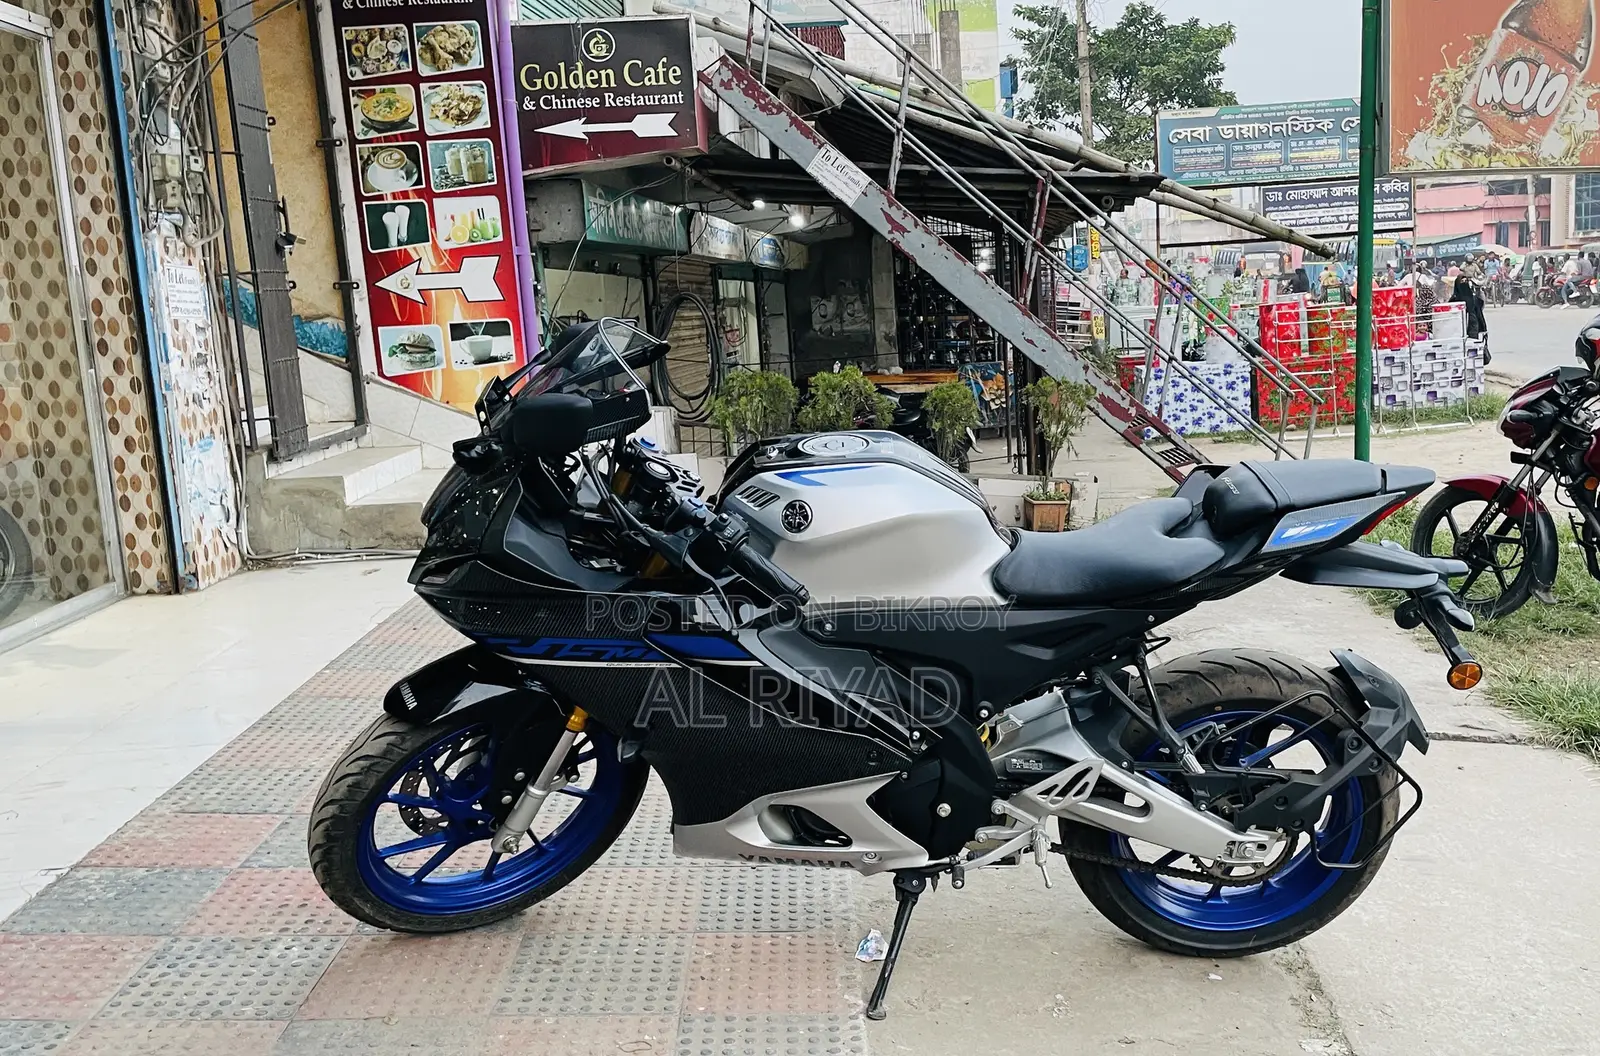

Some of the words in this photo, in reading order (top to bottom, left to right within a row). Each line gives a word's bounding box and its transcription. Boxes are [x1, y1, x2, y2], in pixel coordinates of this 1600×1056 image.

[520, 59, 617, 91] Golden
[623, 57, 682, 87] Cafe
[522, 96, 536, 110] &
[539, 94, 600, 110] Chinese
[604, 91, 684, 107] Restaurant
[1476, 60, 1569, 117] MOJO
[1168, 125, 1213, 144] সেবা
[1216, 116, 1335, 141] ডায়াগনস্টিক
[821, 147, 831, 162] To
[831, 157, 846, 173] Let
[1265, 191, 1283, 202] ডাঃ
[1382, 179, 1410, 194] কবির
[738, 853, 855, 868] YAMAHA
